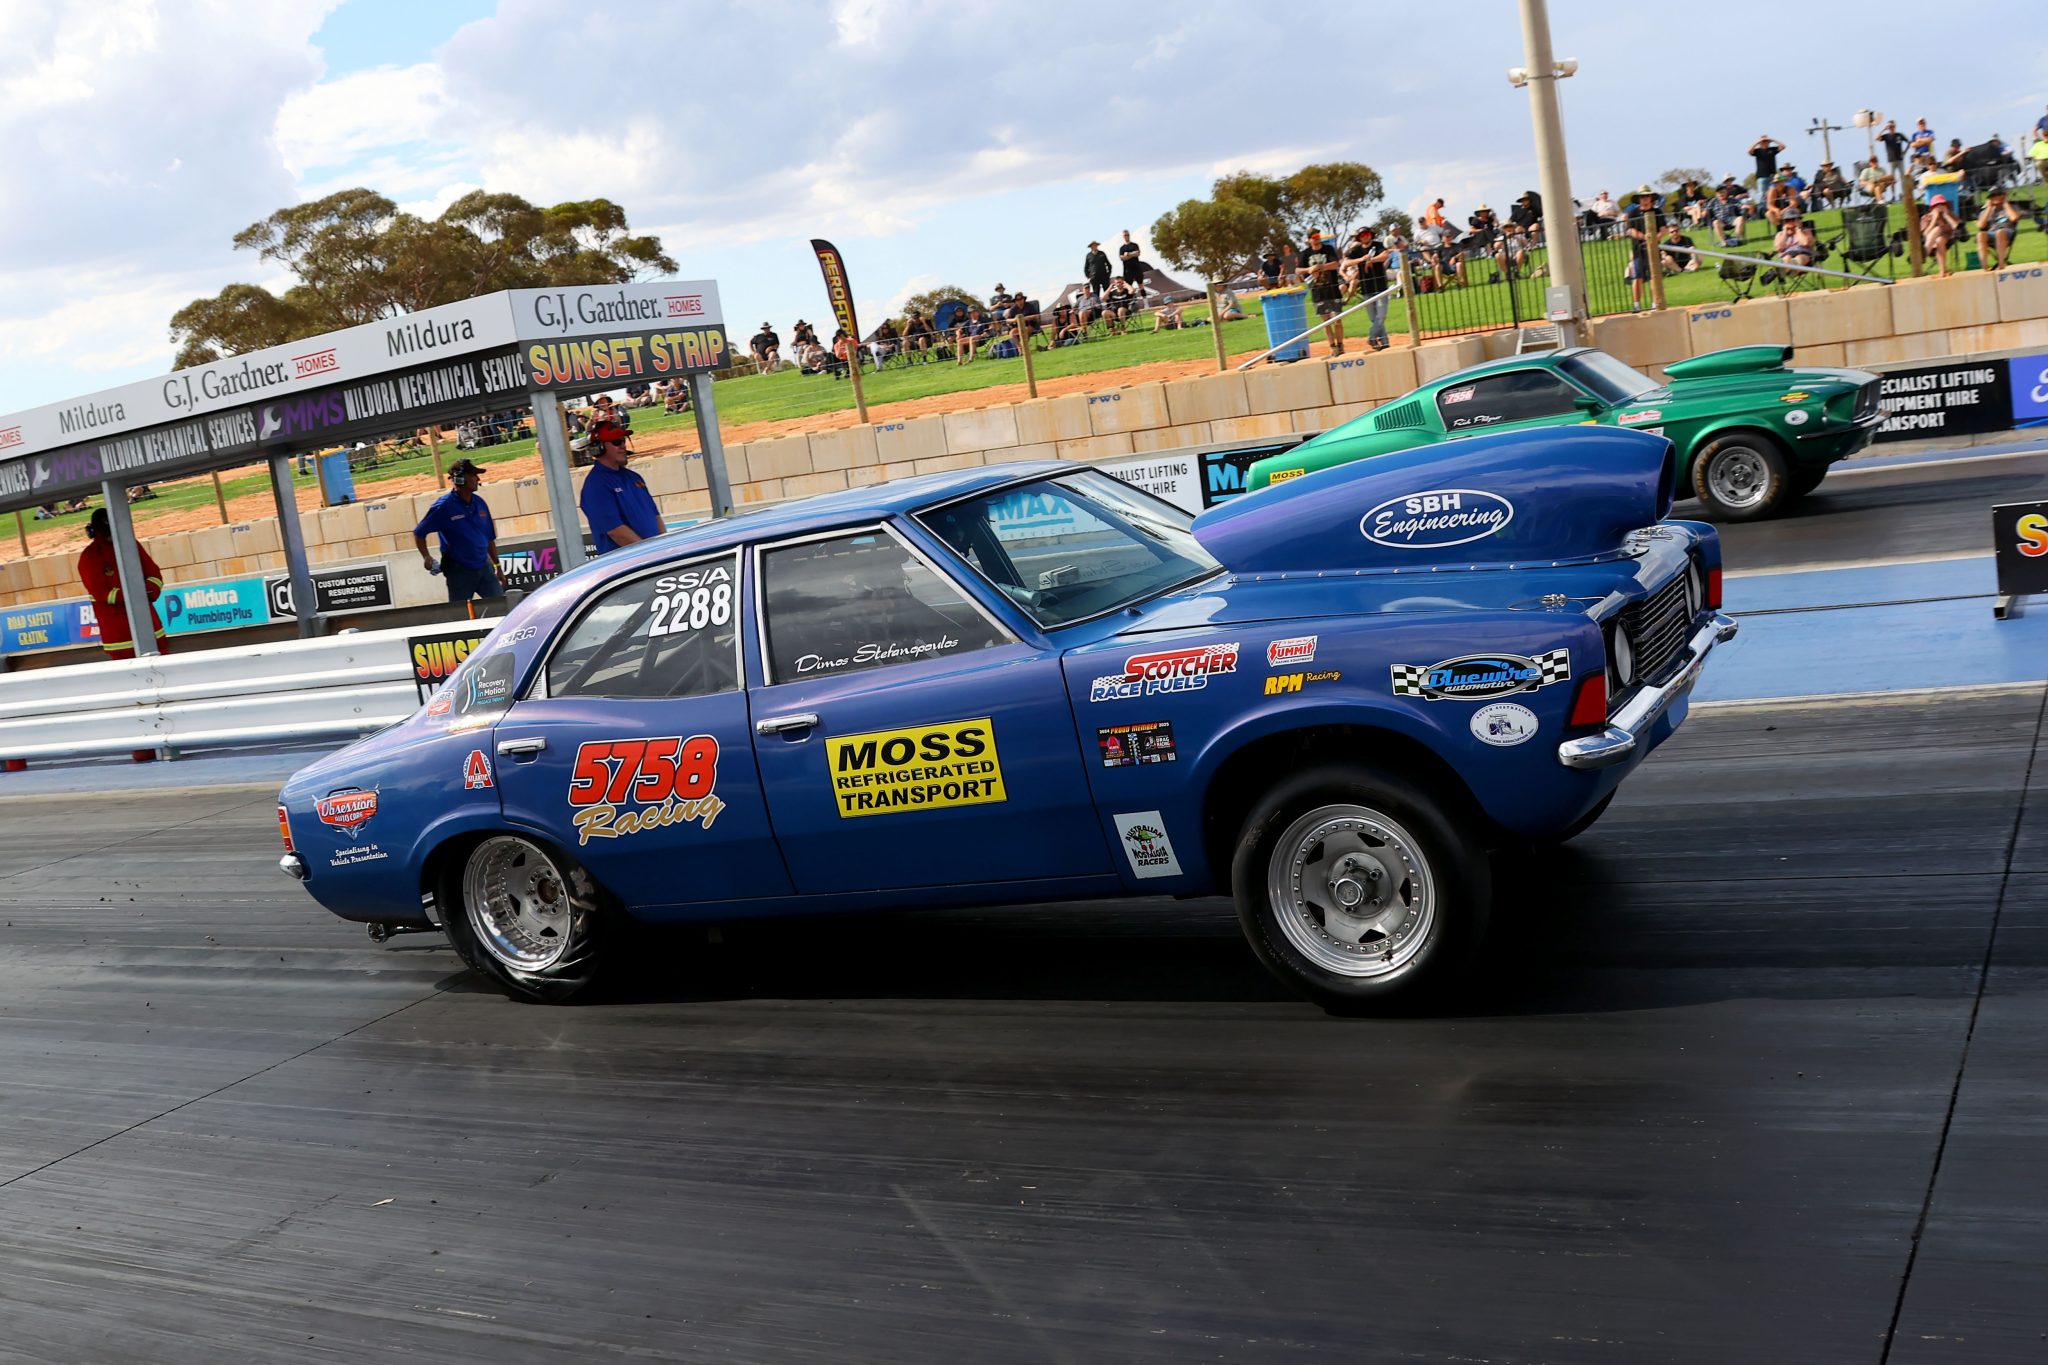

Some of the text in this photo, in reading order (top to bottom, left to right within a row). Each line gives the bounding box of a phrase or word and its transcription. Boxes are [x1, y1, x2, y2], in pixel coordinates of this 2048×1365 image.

[1998, 268, 2043, 282] FWG
[819, 252, 855, 336] AEROFLO
[534, 290, 702, 333] G.J. Gardner. HOMES
[1691, 309, 1733, 322] FWG
[386, 317, 475, 357] Mildura
[529, 330, 725, 386] SUNSET STRIP
[1330, 358, 1366, 371] FWG
[164, 353, 336, 411] G.J. Gardner. HOMES
[1940, 368, 1996, 388] LIFTING
[283, 391, 345, 435] MMS
[344, 380, 400, 421] MILDURA
[398, 363, 481, 409] MECHANICAL
[1089, 394, 1121, 405] FWG
[1880, 389, 1980, 413] UIPMENT HIRE
[59, 402, 126, 434] Mildura
[876, 423, 905, 433] FWG
[51, 411, 257, 484] MMS MILDURA MECHANICAL SERVICES
[684, 452, 703, 461] FW
[1109, 463, 1188, 481] IALIST LIFTING
[1272, 470, 1303, 480] MOSS
[1153, 481, 1177, 494] HIRE
[1405, 493, 1461, 514] SBH
[1373, 508, 1504, 540] Engineering
[318, 574, 384, 589] CUSTOM CONCRETE
[654, 565, 732, 594] SS/A
[184, 588, 238, 609] Mildura
[328, 585, 376, 597] RESURFACING
[27, 611, 53, 627] SAFETY
[187, 607, 253, 625] Plumbing Plus
[648, 583, 733, 638] 2288
[795, 654, 849, 673] Dimos
[1125, 648, 1236, 683] SCOTCHER
[478, 678, 506, 691] Recovery
[1264, 671, 1341, 695] RPM Racing
[1428, 662, 1538, 688] Bluewire
[484, 687, 506, 696] Motion
[1092, 675, 1207, 701] RACE FUELS
[1444, 681, 1516, 692] automotive
[1131, 723, 1158, 732] MEMBER
[837, 727, 986, 771] MOSS
[568, 734, 719, 807] 5758
[836, 759, 995, 790] REFRIGERATED
[840, 778, 997, 811] TRANSPORT
[321, 797, 374, 817] Obsession
[573, 795, 726, 846] Racing
[1125, 825, 1163, 841] AUSTRALIAN
[1131, 846, 1169, 859] NOSTALGIA
[1137, 857, 1169, 867] RACERS
